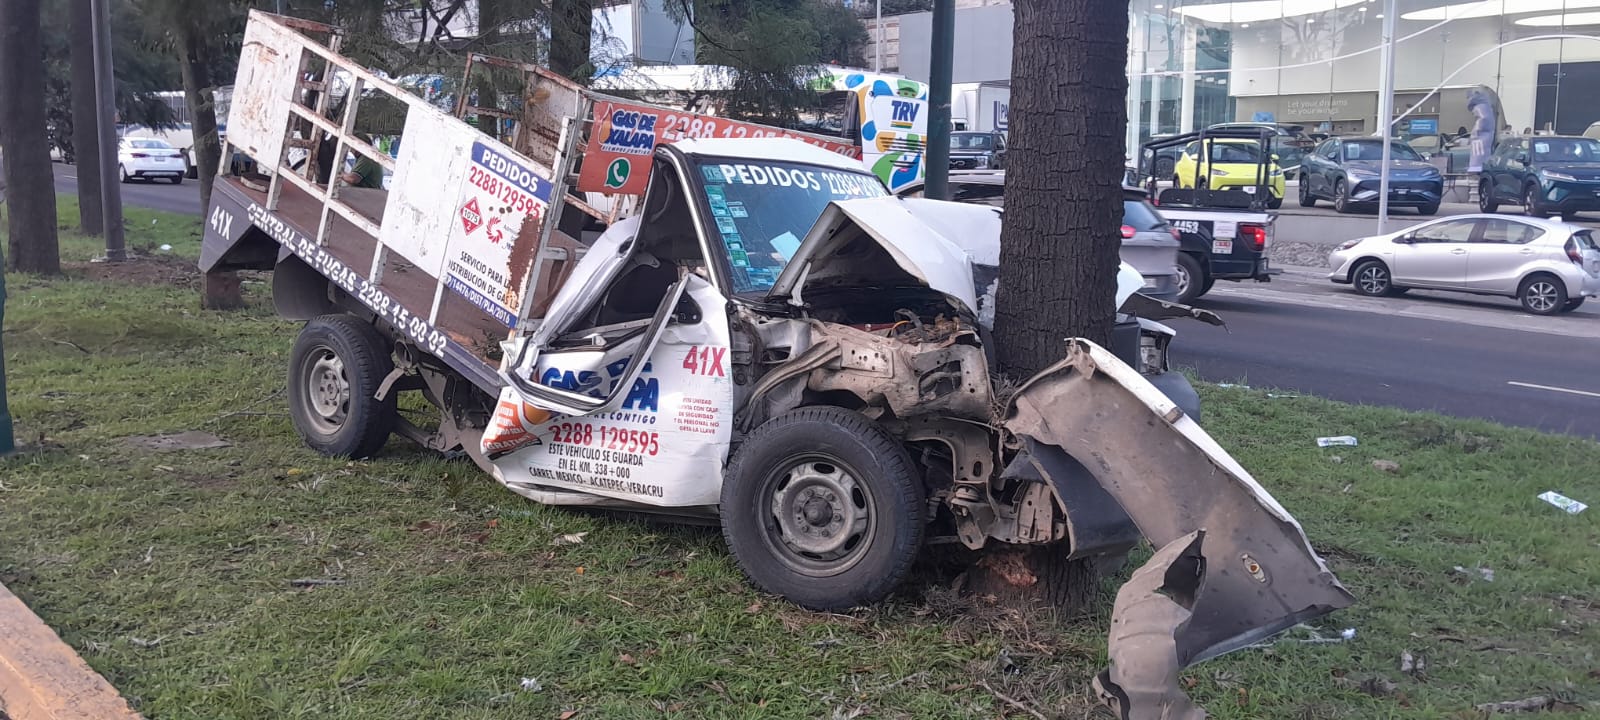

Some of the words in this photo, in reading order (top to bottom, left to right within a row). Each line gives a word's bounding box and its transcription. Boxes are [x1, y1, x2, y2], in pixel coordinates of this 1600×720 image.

[612, 110, 640, 128] GAS
[640, 114, 657, 131] DE
[892, 101, 920, 122] TRV
[662, 114, 716, 140] 2288
[605, 128, 656, 150] XALAPA
[481, 149, 539, 193] PEDIDOS
[719, 164, 821, 191] PEDIDOS
[469, 166, 542, 220] 2288129595
[210, 205, 233, 241] 41X
[464, 209, 479, 224] 1075
[460, 251, 487, 275] SERVICIO
[488, 267, 502, 284] PARA
[247, 203, 296, 252] CENTRAL
[298, 238, 316, 264] DE
[315, 250, 357, 292] FUGAS
[358, 280, 390, 316] 2288
[392, 304, 409, 329] 15
[409, 317, 427, 343] 00
[428, 330, 447, 358] 02
[487, 284, 496, 297] DE
[683, 346, 726, 377] 41X
[609, 412, 657, 425] CONTIGO
[683, 418, 709, 427] PERSONAL
[685, 412, 714, 420] SEGURIDAD
[548, 422, 594, 447] 2288
[600, 426, 660, 456] 129595
[700, 427, 716, 435] LLAVE
[548, 443, 563, 455] ESTE
[565, 444, 601, 460] VEHICULO
[602, 450, 611, 462] SE
[612, 451, 644, 467] GUARDA
[558, 458, 568, 469] EN
[569, 459, 577, 471] EL
[579, 461, 592, 473] KM.
